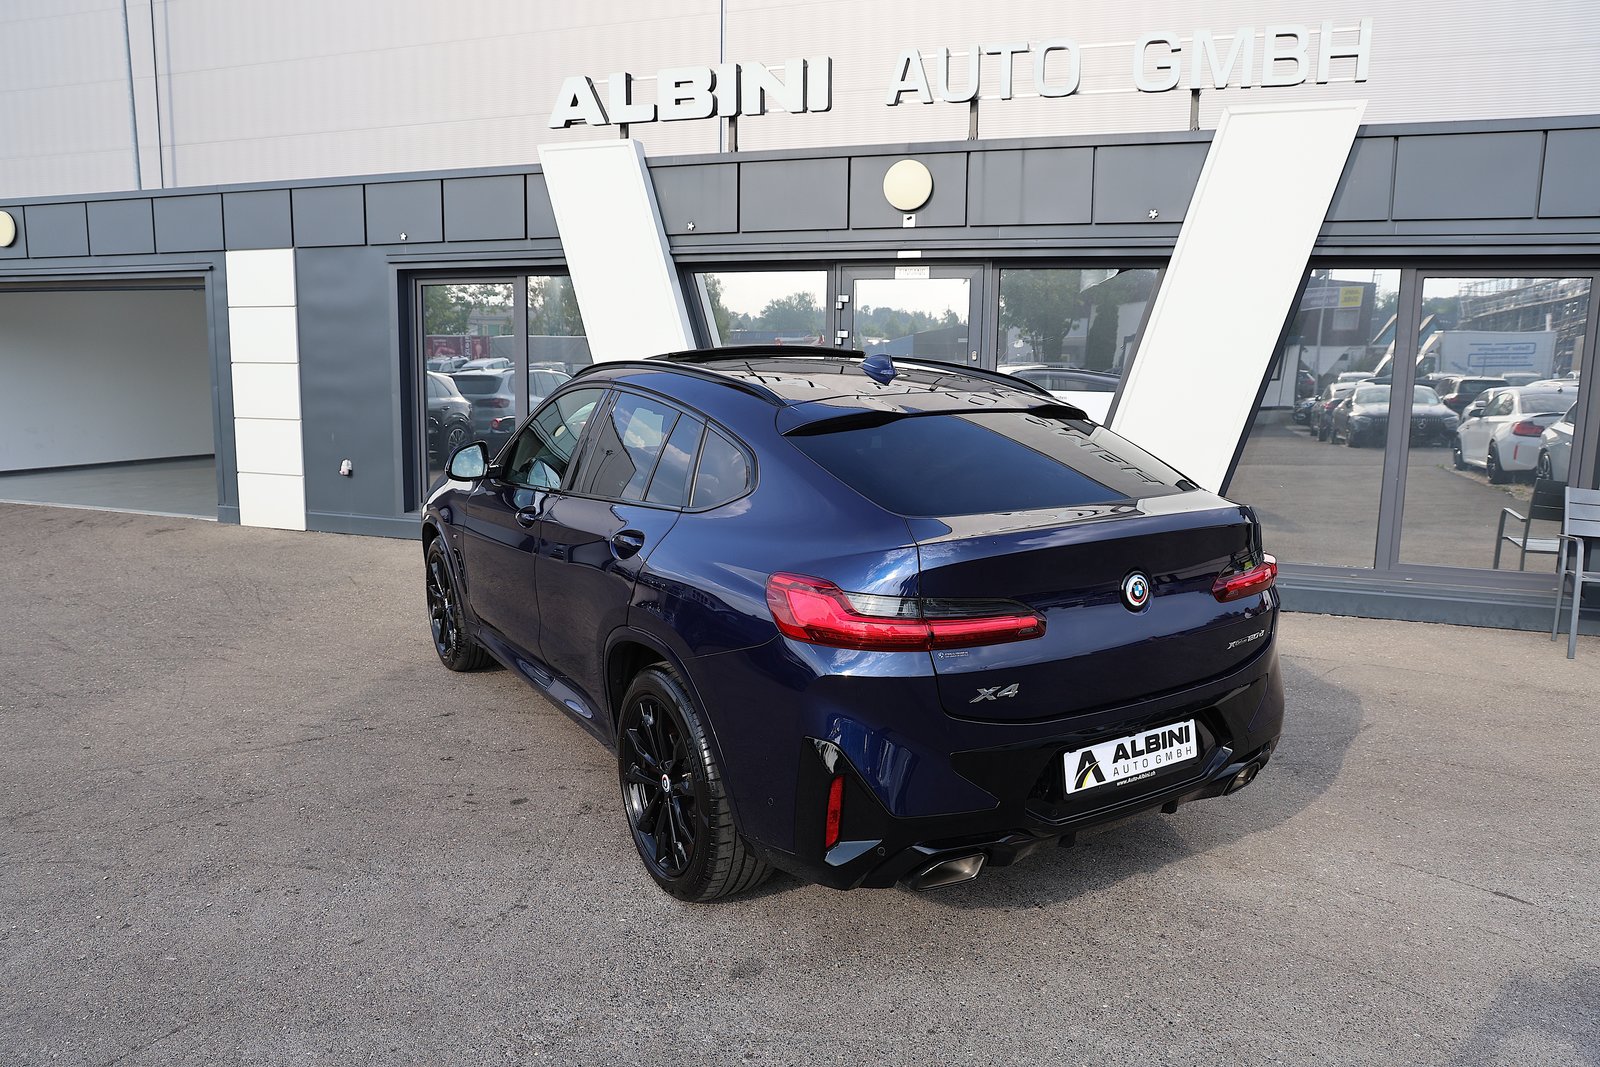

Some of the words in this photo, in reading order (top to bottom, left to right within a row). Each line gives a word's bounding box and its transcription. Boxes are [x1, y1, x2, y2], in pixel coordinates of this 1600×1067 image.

[549, 56, 832, 128] ALBINI
[887, 38, 1081, 106] AUTO
[1132, 17, 1374, 93] GMBH
[969, 683, 1020, 703] X4
[1112, 725, 1190, 764] ALBINI
[1113, 758, 1149, 777] AUTO
[1155, 746, 1192, 764] GMBH
